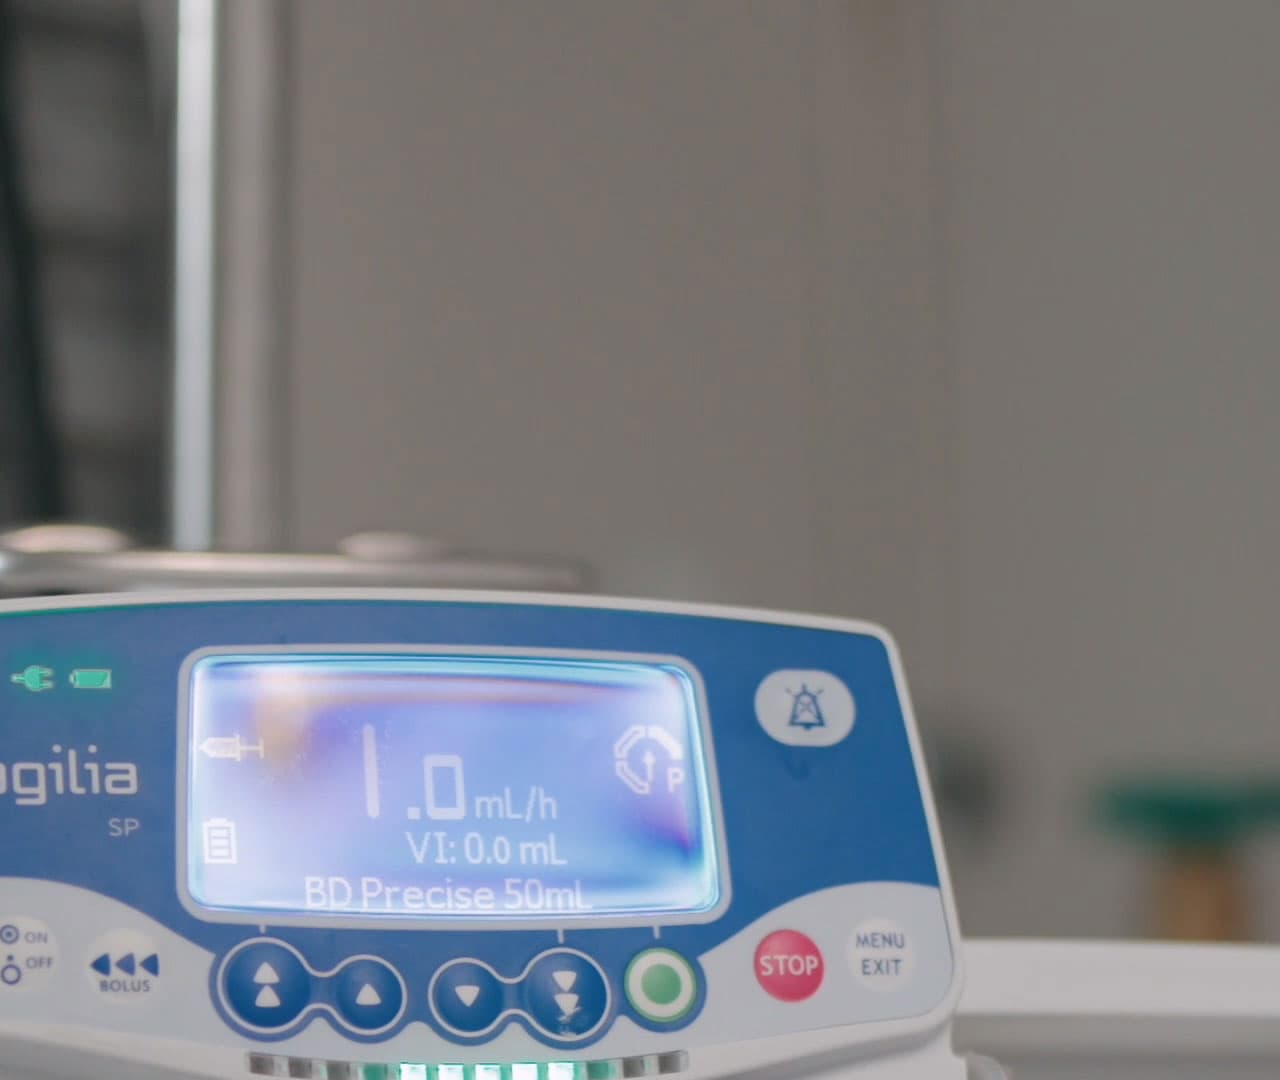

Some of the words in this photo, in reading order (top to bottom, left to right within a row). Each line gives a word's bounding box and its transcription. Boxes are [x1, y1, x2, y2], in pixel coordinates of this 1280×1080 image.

[475, 785, 558, 823] mL/h
[108, 817, 140, 837] SP
[405, 831, 457, 864] VI:
[464, 831, 511, 865] 0.0
[519, 833, 568, 865] mL
[304, 876, 353, 909] BD
[360, 877, 495, 911] Precise
[504, 877, 593, 911] 50mL
[24, 930, 48, 945] ON
[856, 932, 905, 949] MENU
[25, 955, 54, 971] OFF
[760, 954, 819, 978] STOP
[862, 958, 902, 977] EXIT
[99, 979, 151, 993] BOLUS
